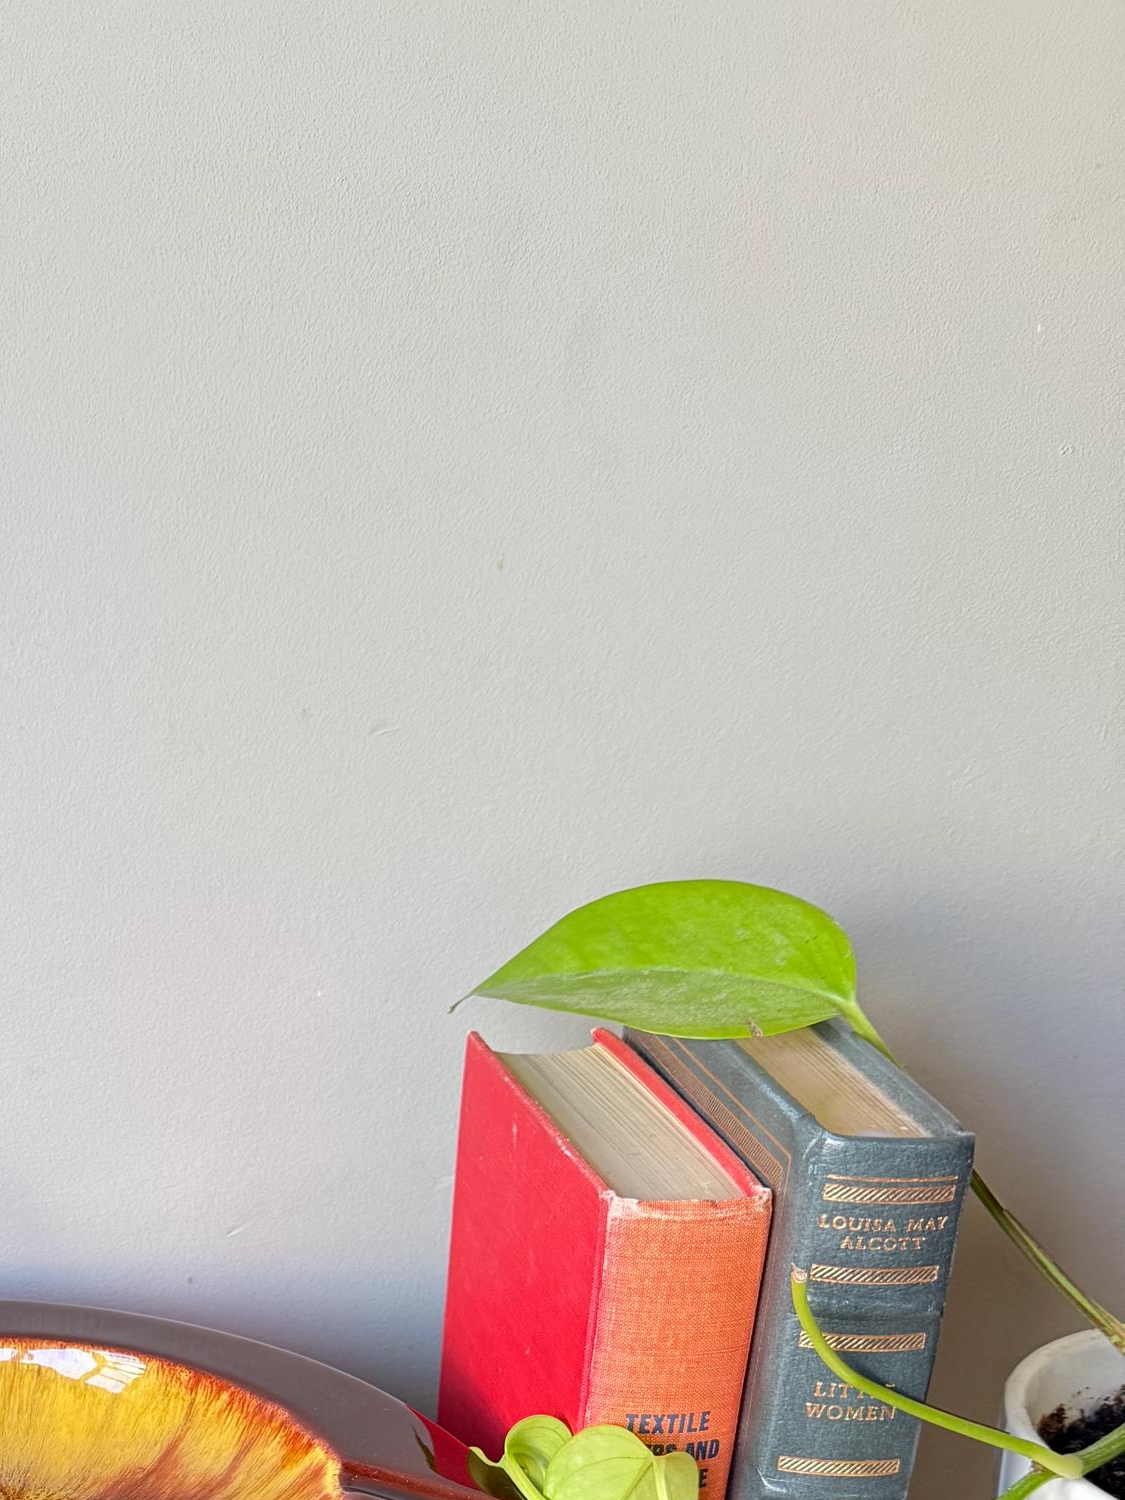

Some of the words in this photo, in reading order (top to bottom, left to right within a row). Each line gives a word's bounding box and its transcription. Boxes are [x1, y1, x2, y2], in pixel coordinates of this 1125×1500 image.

[818, 1214, 897, 1233] LOUISA
[906, 1215, 949, 1233] MAY
[839, 1235, 927, 1251] ALCOTT
[805, 1402, 896, 1422] WOMEN
[625, 1411, 711, 1435] TEXTILE
